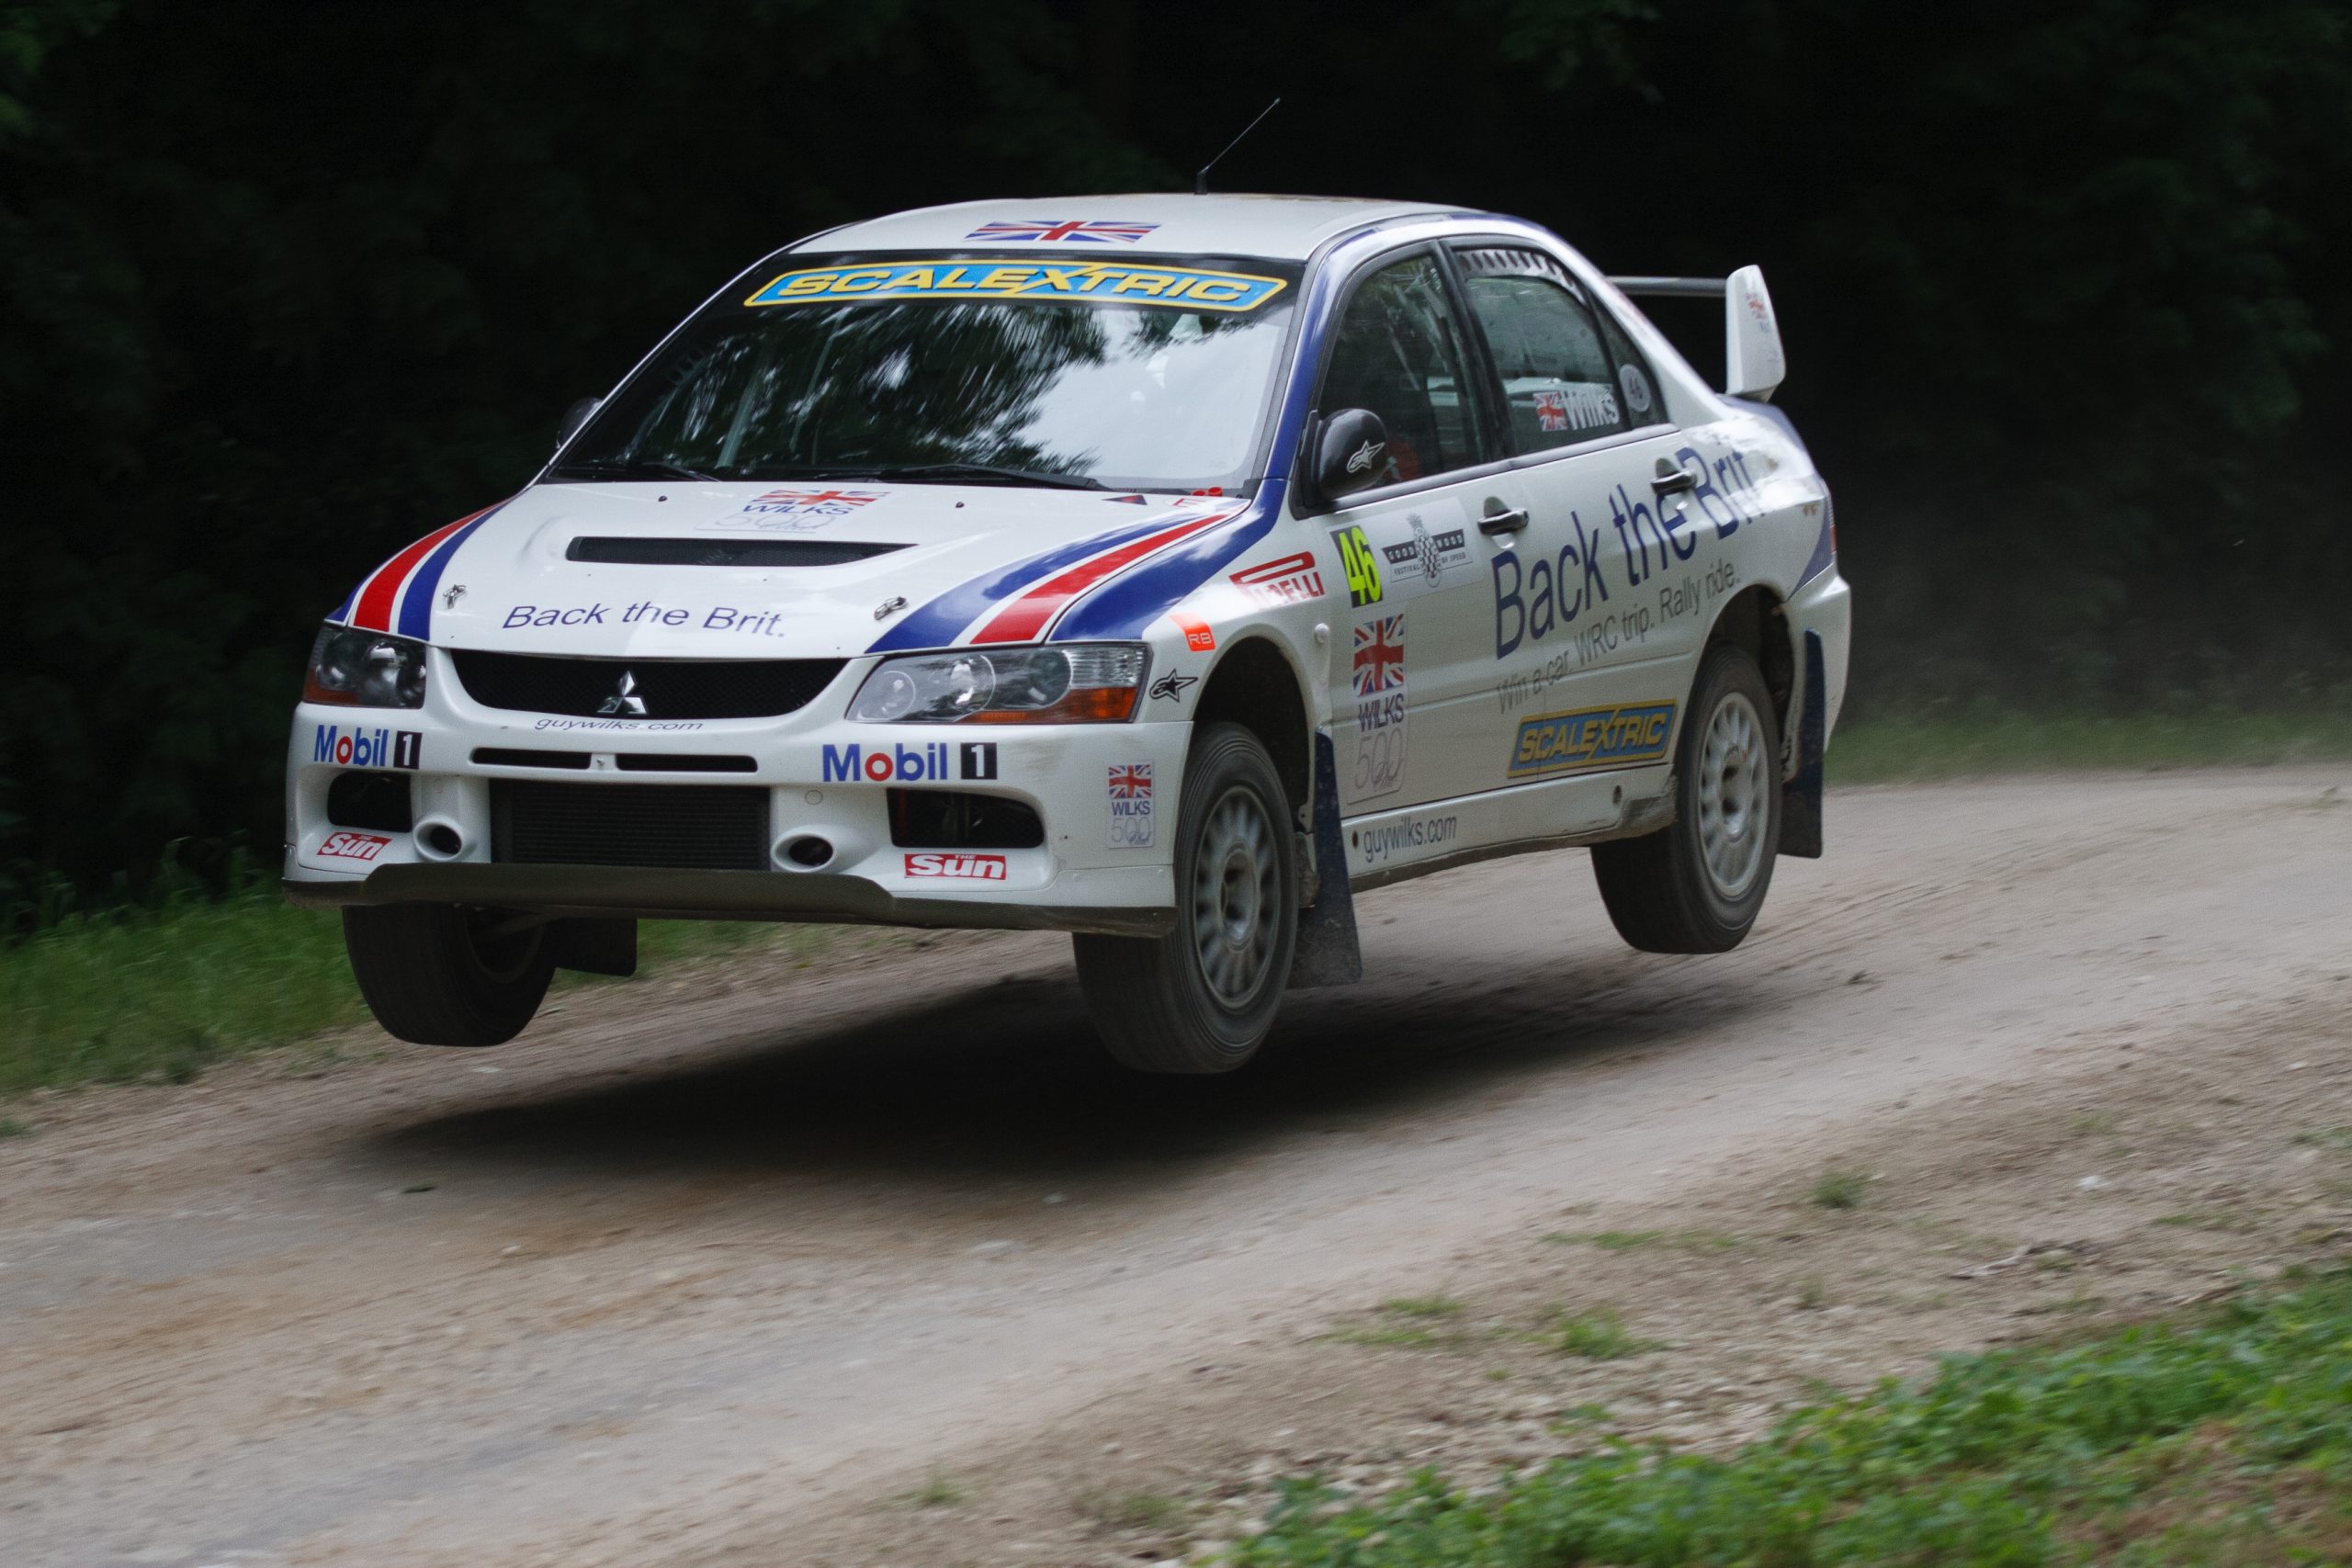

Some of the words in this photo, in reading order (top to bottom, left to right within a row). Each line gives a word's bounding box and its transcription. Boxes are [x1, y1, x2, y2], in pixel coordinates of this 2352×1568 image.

[777, 266, 1251, 301] SCALEXTRIC
[742, 505, 855, 515] WILKS
[1338, 526, 1381, 606] 46
[1490, 510, 1609, 660] Back
[1608, 483, 1697, 587] the
[502, 603, 611, 629] Back
[621, 601, 690, 626] the
[702, 606, 785, 637] Brit.
[1496, 676, 1529, 715] Win
[1532, 668, 1543, 695] a
[1574, 615, 1617, 667] WRC
[1622, 603, 1654, 643] trip.
[1659, 575, 1701, 624] Rally
[1705, 557, 1741, 601] ride.
[534, 717, 705, 731] guywilks.com
[1358, 693, 1405, 733] WILKS
[313, 724, 390, 767] Mobil
[1519, 713, 1667, 764] SCALEXTRIC
[822, 742, 948, 783] Mobil
[1111, 800, 1151, 816] WILKS
[322, 833, 384, 861] Sun
[1363, 815, 1457, 863] guywilks.com
[907, 854, 1005, 879] Sun
